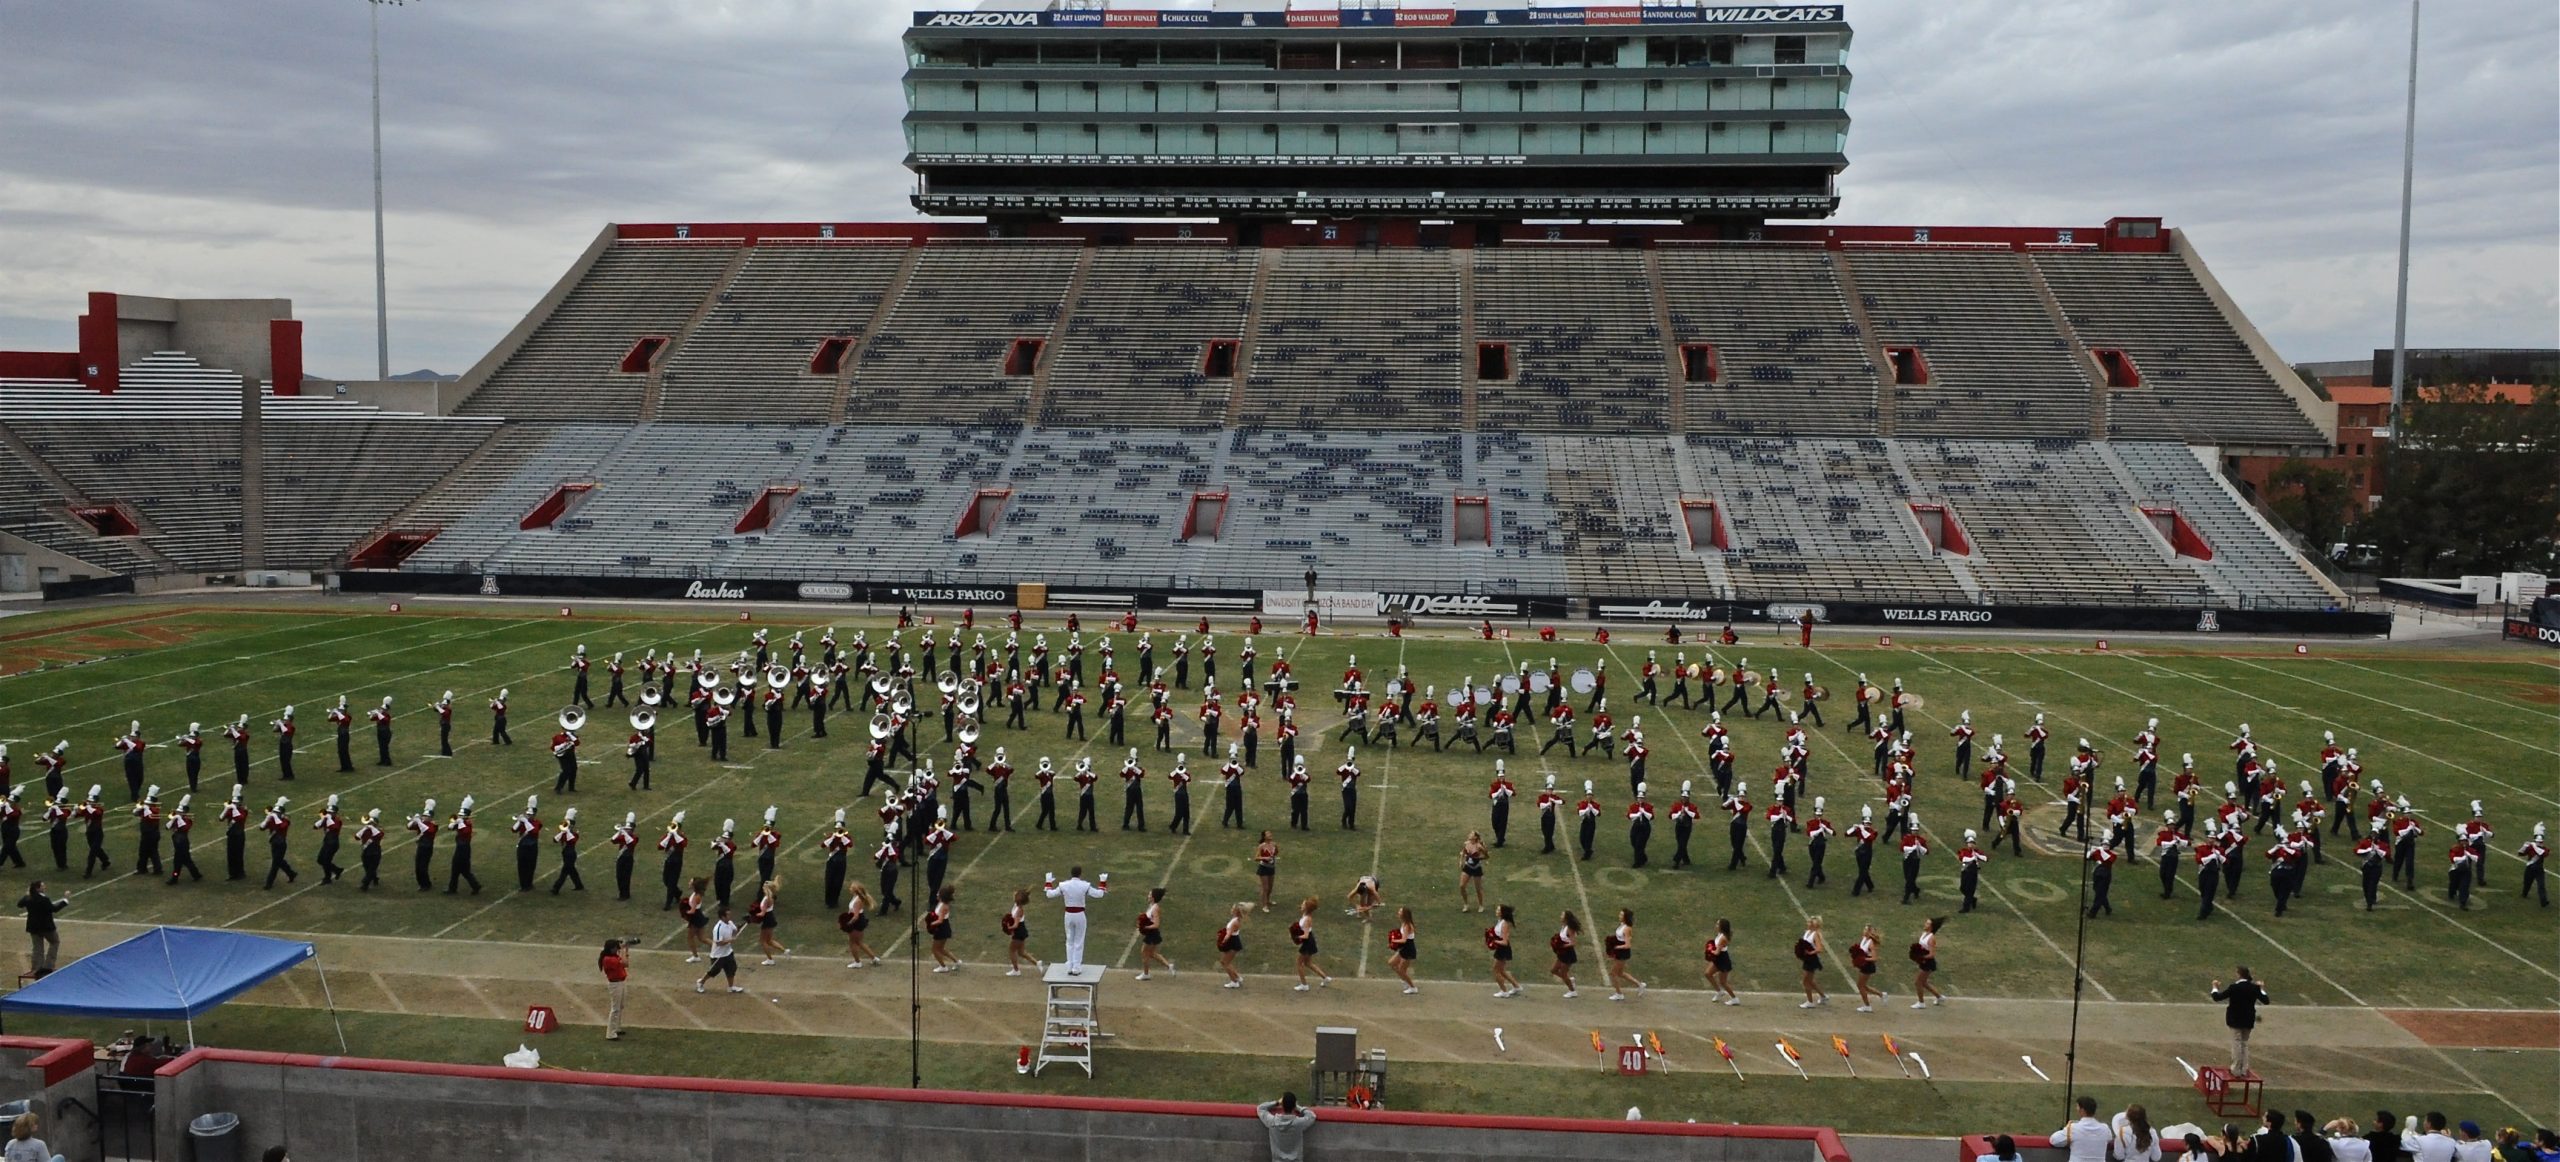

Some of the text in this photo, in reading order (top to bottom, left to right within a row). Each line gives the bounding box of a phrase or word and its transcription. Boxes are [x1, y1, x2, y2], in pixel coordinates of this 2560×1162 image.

[926, 13, 1038, 27] ARIZONA
[1074, 14, 1101, 22] LUPPINO
[1167, 14, 1190, 22] CHUCK
[1191, 14, 1209, 22] CECIL
[1319, 14, 1339, 22] LEWIS
[1418, 13, 1449, 21] WALDROP
[1592, 12, 1609, 20] CHRIS
[1610, 11, 1641, 19] McALISTER
[1674, 11, 1697, 19] CASON
[1705, 8, 1835, 22] WILDCATS
[677, 230, 688, 239] 17
[822, 229, 833, 238] 18
[1178, 230, 1191, 239] 20
[1324, 229, 1336, 239] 21
[1547, 231, 1560, 241] 22
[1748, 231, 1761, 241] 23
[1914, 233, 1928, 242] 24
[2058, 234, 2072, 244] 25
[88, 366, 98, 376] 15
[336, 384, 346, 393] 16
[685, 581, 748, 599] Bashas'
[904, 589, 1005, 601] WELLS FARGO
[1266, 597, 1301, 608] UNIVERSITY
[1342, 600, 1360, 609] BAND
[1361, 600, 1375, 609] DAY
[1883, 609, 1992, 622] WELLS FARGO
[2508, 622, 2538, 639] BEAR
[528, 1010, 545, 1029] 40
[1623, 1051, 1641, 1070] 40
